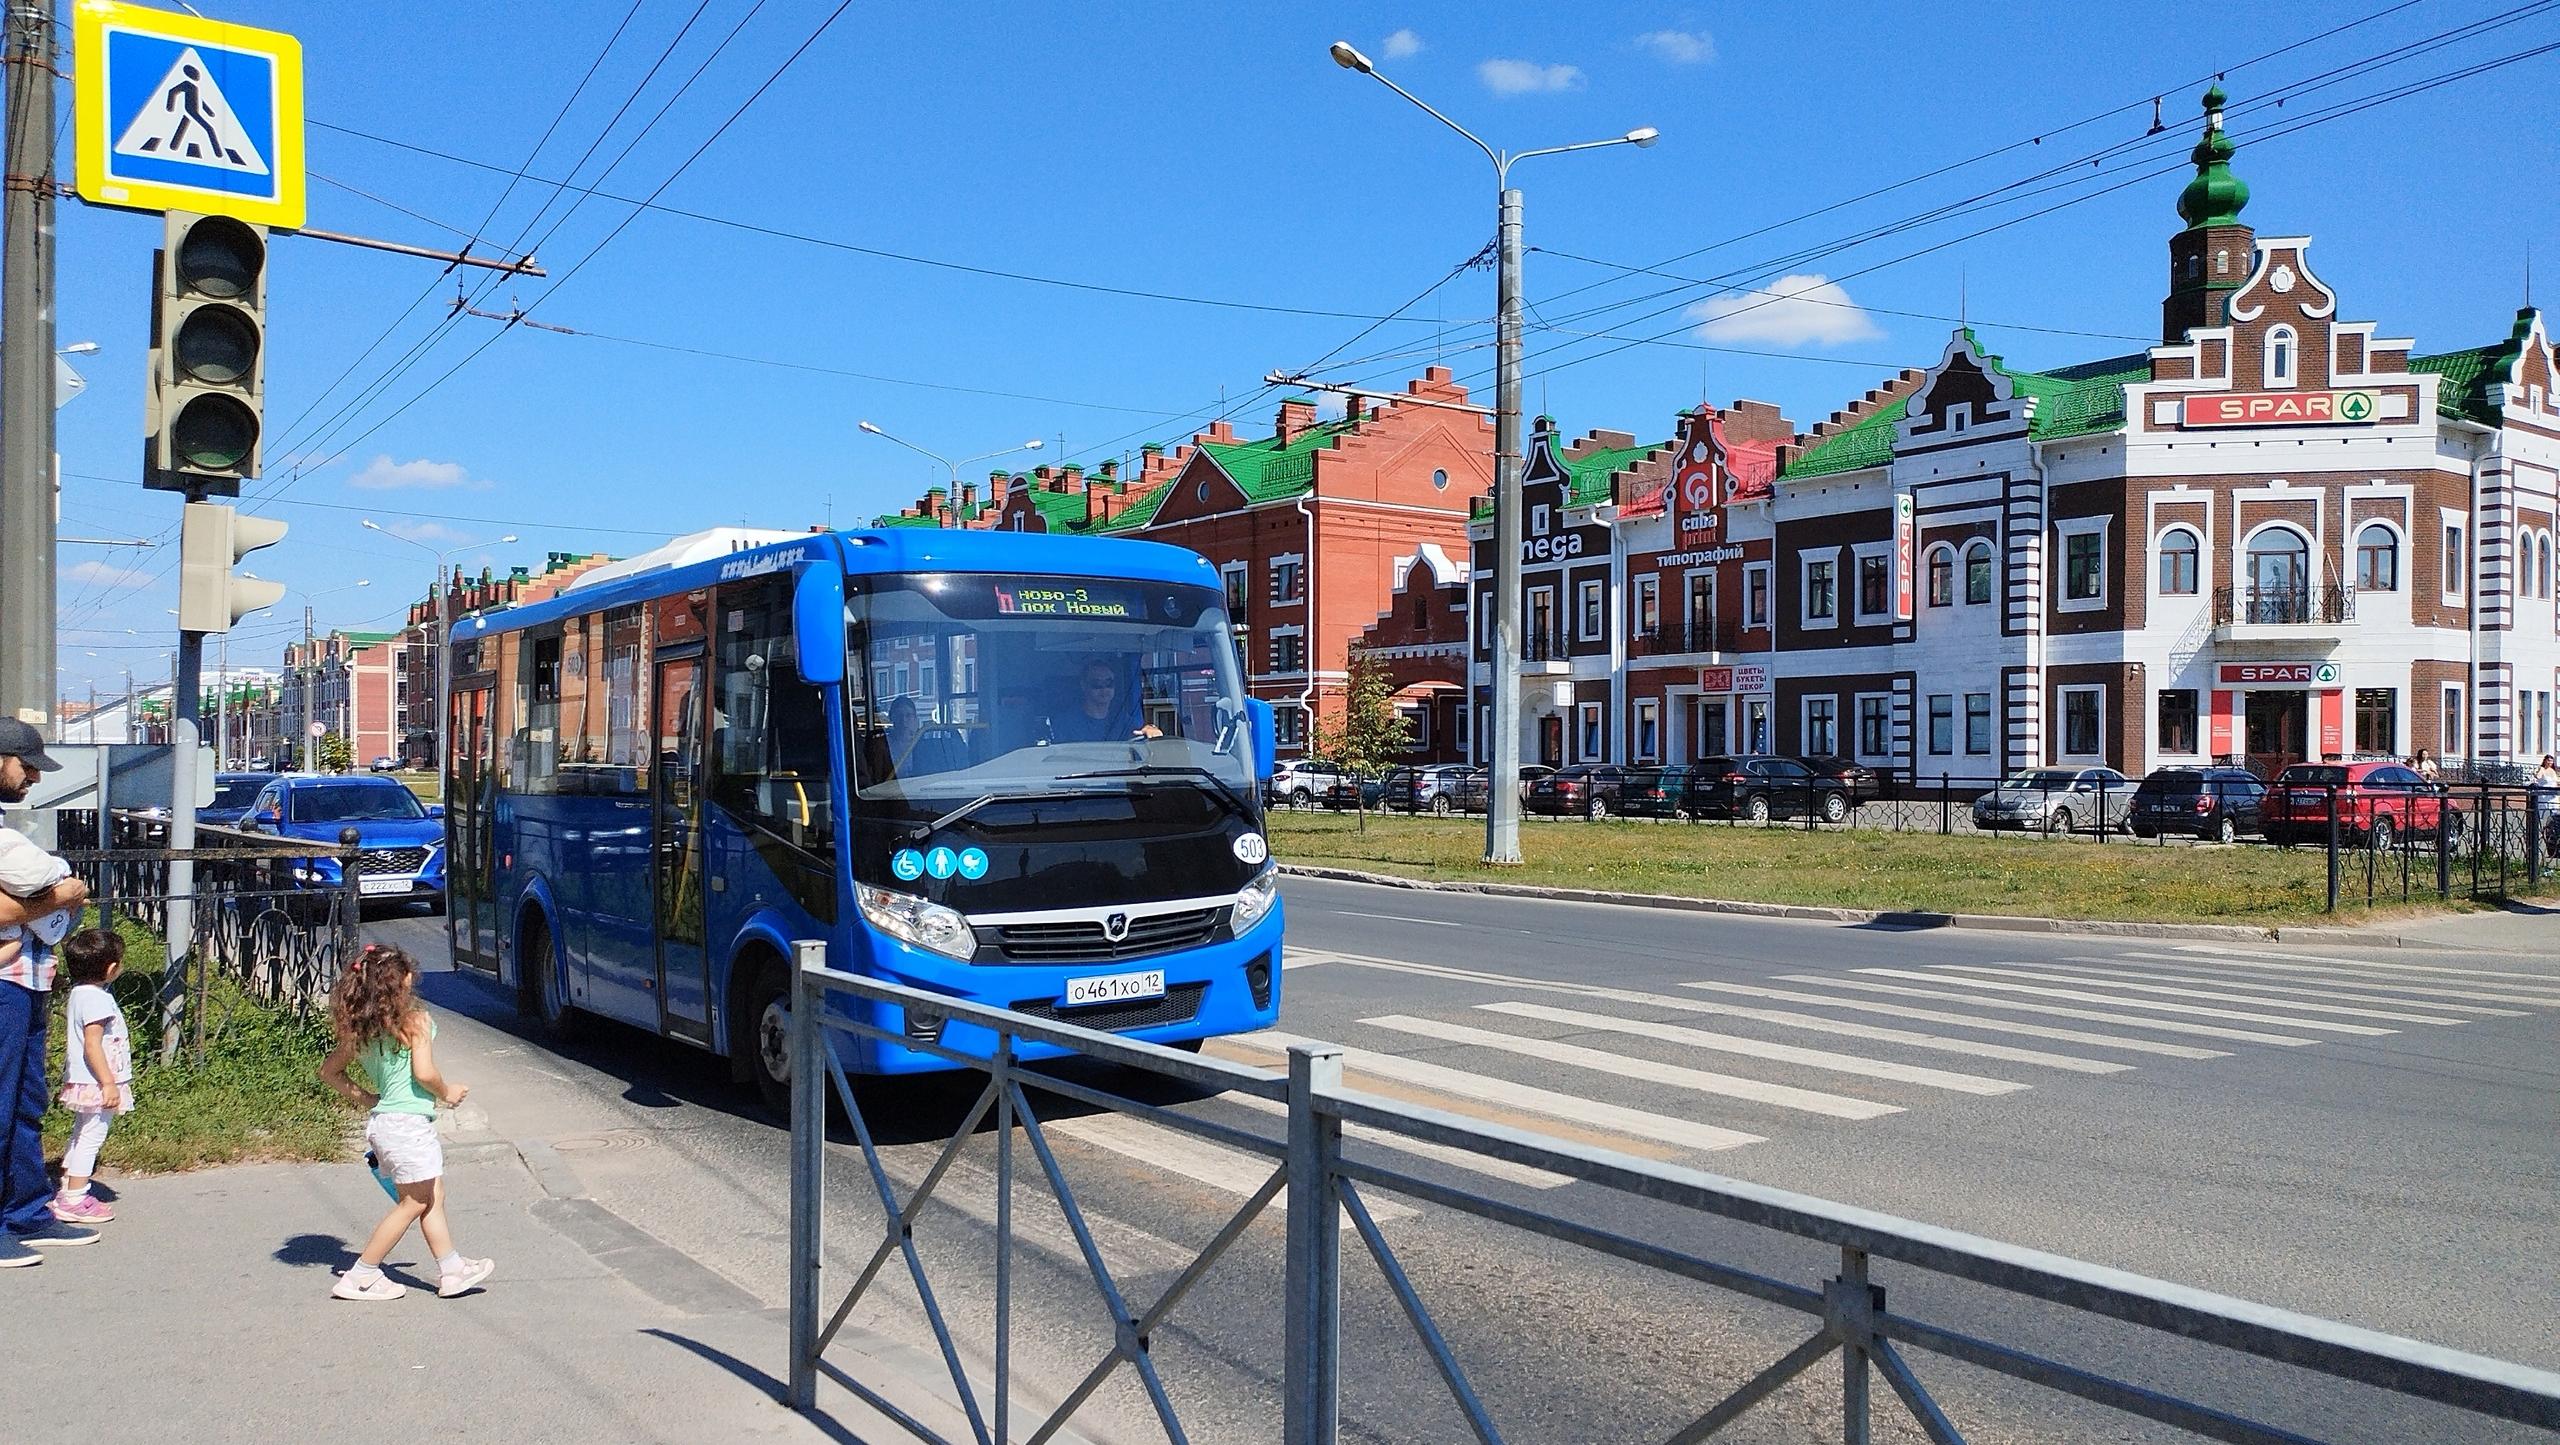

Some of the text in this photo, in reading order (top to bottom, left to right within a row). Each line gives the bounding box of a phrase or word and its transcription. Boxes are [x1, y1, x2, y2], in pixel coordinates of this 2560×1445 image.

[2220, 397, 2332, 419] SPAR
[1656, 543, 1745, 568] типографий
[1901, 523, 1911, 594] SPAR
[1066, 601, 1125, 616] Новый
[1738, 667, 1764, 675] ЦВЕТЫ
[2241, 667, 2310, 680] SPAR
[1736, 675, 1767, 683] БУКЕТЫ
[1739, 683, 1764, 691] ДЕКОР
[1241, 839, 1265, 859] 503
[1145, 973, 1159, 988] 12
